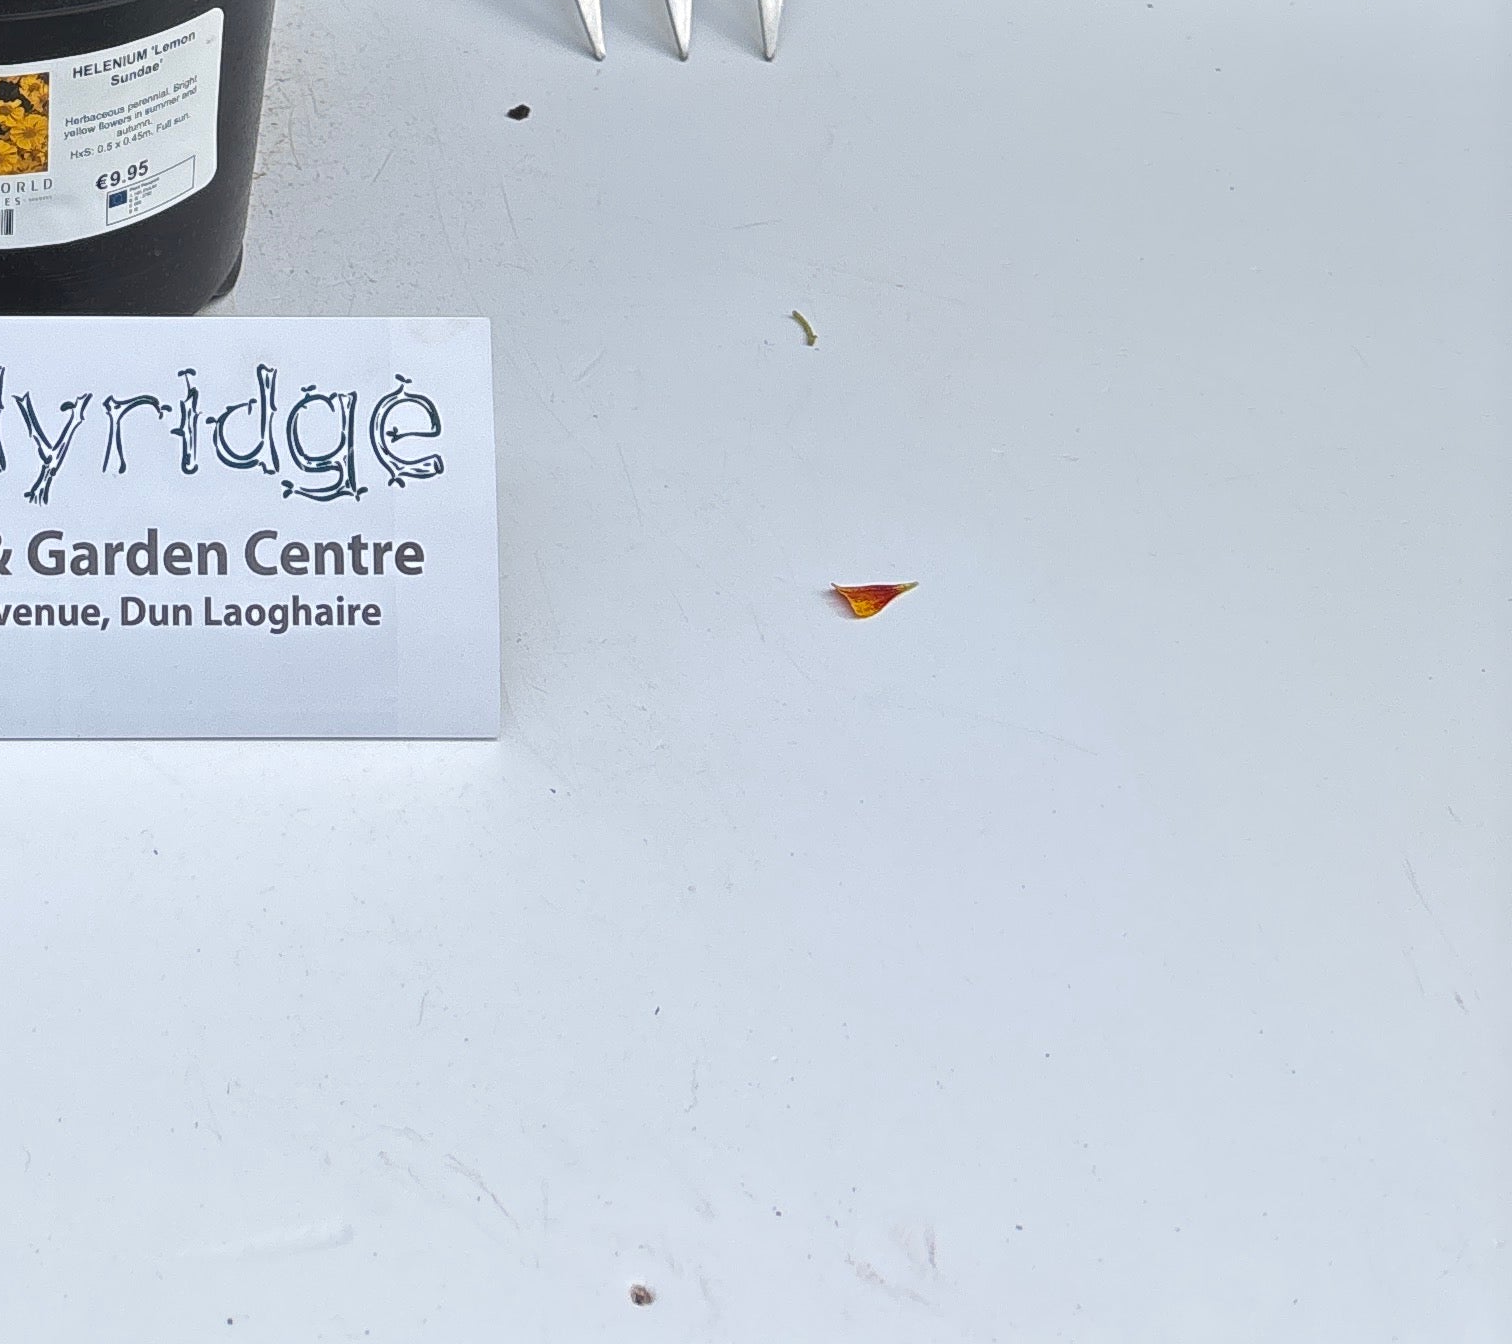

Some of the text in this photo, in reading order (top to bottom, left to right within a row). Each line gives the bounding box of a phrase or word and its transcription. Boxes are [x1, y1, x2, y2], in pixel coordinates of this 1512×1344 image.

[72, 31, 196, 79] HELENIUM 'Lemon
[110, 58, 164, 87] Sundae'
[63, 85, 197, 141] yellow flowers in summer and
[65, 105, 125, 128] Herbaceous
[173, 75, 198, 94] Bright
[97, 141, 113, 154] 0.5
[156, 119, 172, 133] Full
[116, 119, 153, 138] autumn.
[95, 159, 149, 190] €9.95
[26, 528, 229, 578] Garden
[243, 529, 426, 578] Centre
[120, 597, 193, 628] Dun
[203, 595, 382, 635] Laoghaire
